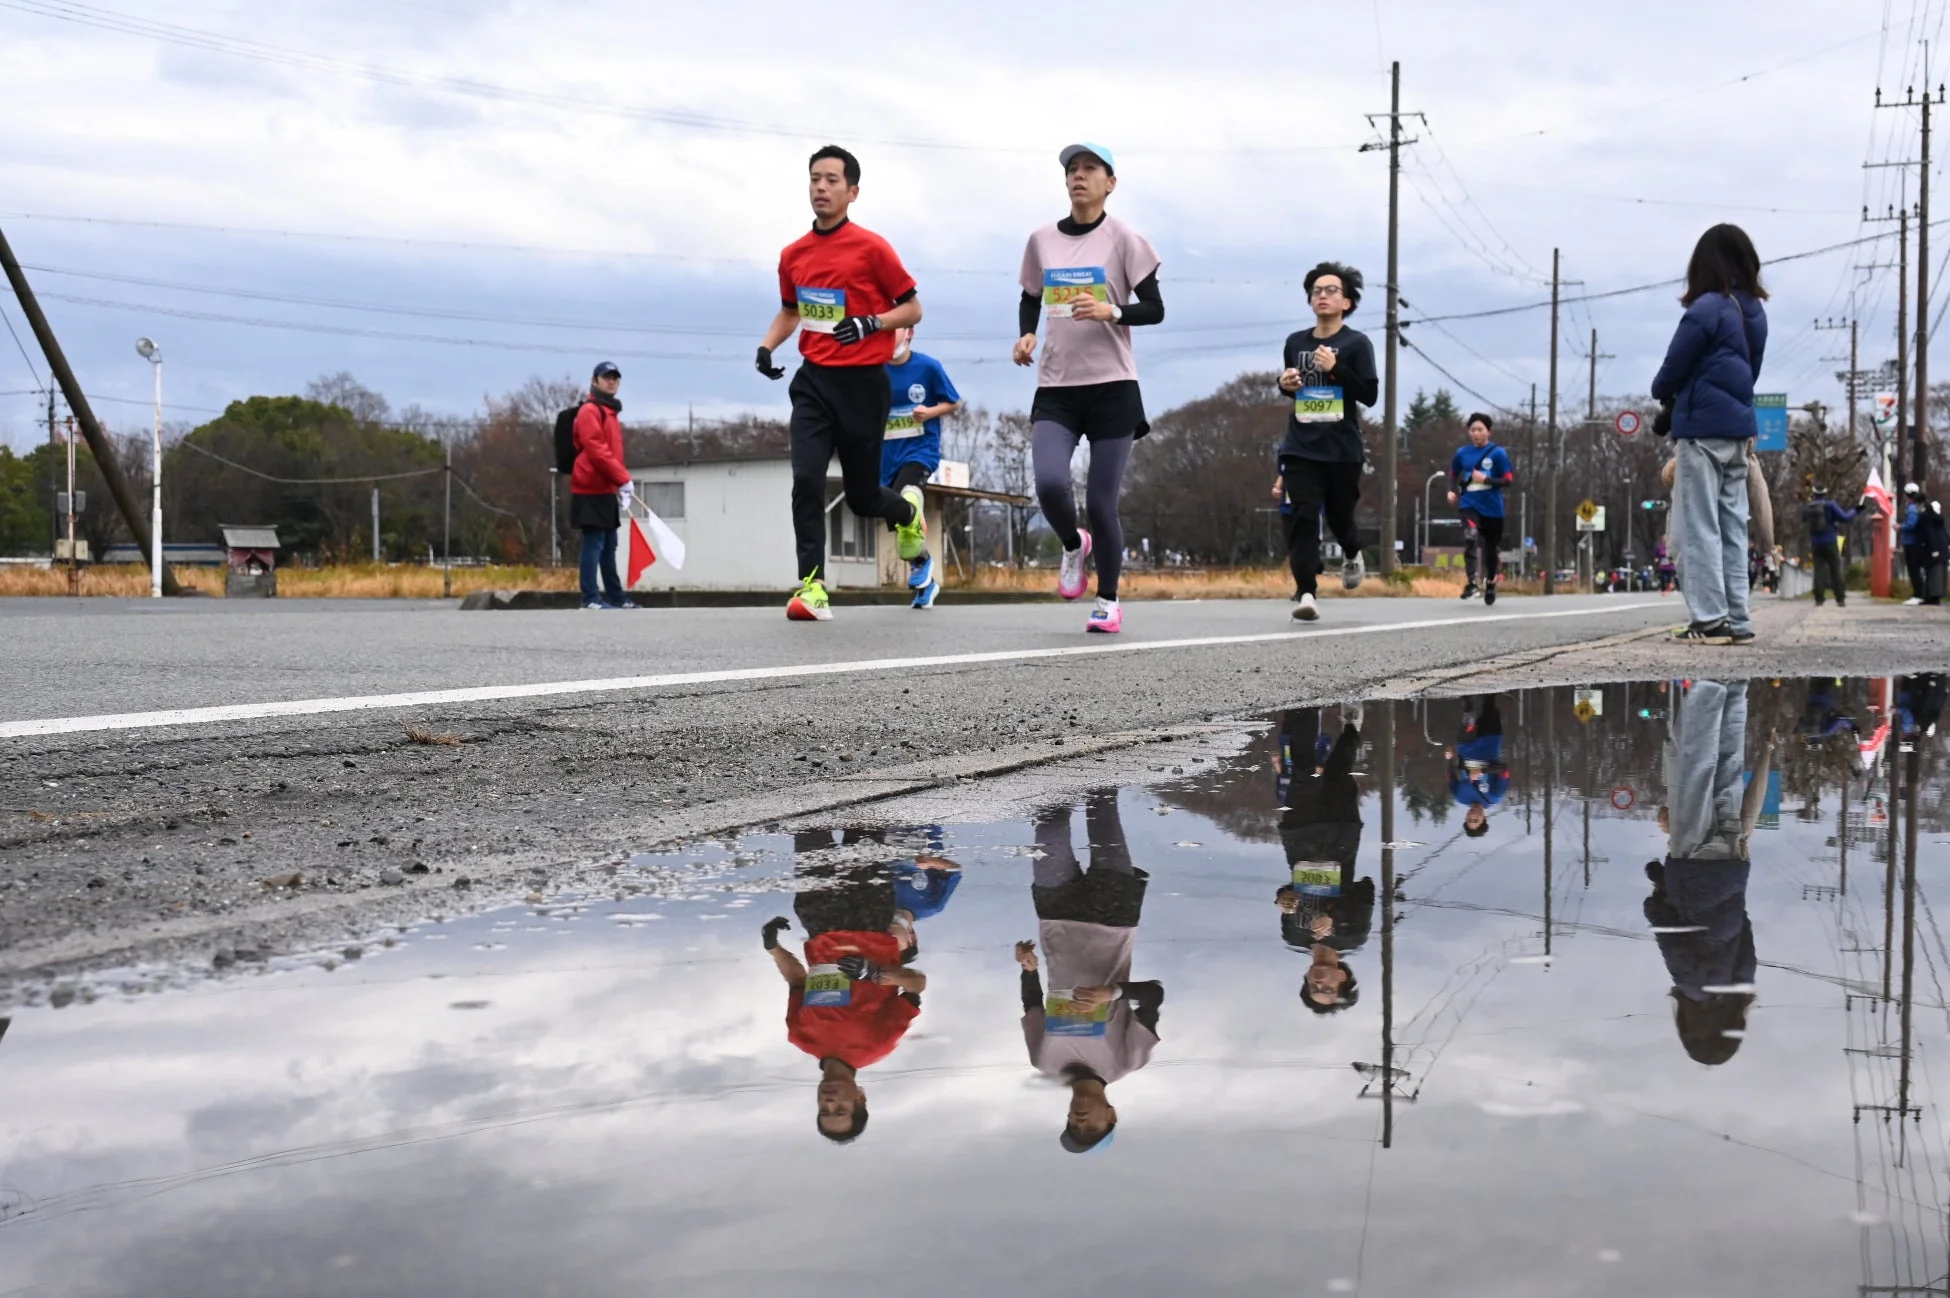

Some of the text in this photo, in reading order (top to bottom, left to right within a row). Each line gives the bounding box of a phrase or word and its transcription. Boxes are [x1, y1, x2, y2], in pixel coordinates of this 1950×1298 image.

[803, 304, 834, 319] 5033
[1303, 400, 1333, 412] 5097
[886, 417, 914, 430] 5419
